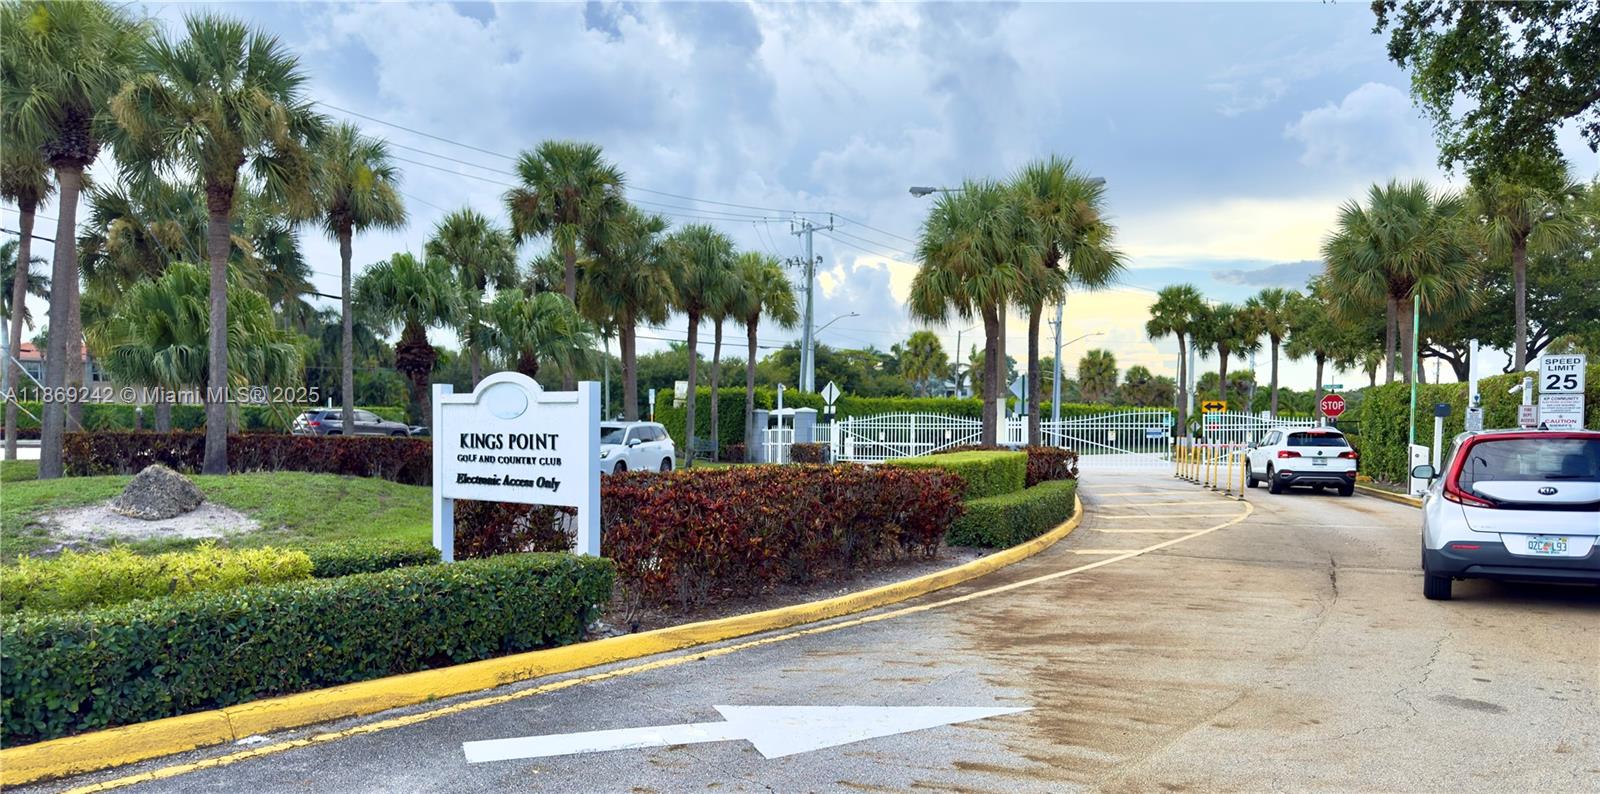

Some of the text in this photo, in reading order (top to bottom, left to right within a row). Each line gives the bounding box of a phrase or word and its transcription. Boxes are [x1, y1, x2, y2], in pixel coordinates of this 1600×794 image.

[1546, 374, 1578, 390] 25
[1322, 401, 1344, 410] STOP
[460, 433, 559, 450] KINGS POINT
[457, 454, 562, 466] GOLF AND COUNTRY CLUB
[456, 473, 561, 492] Electronic Access Only
